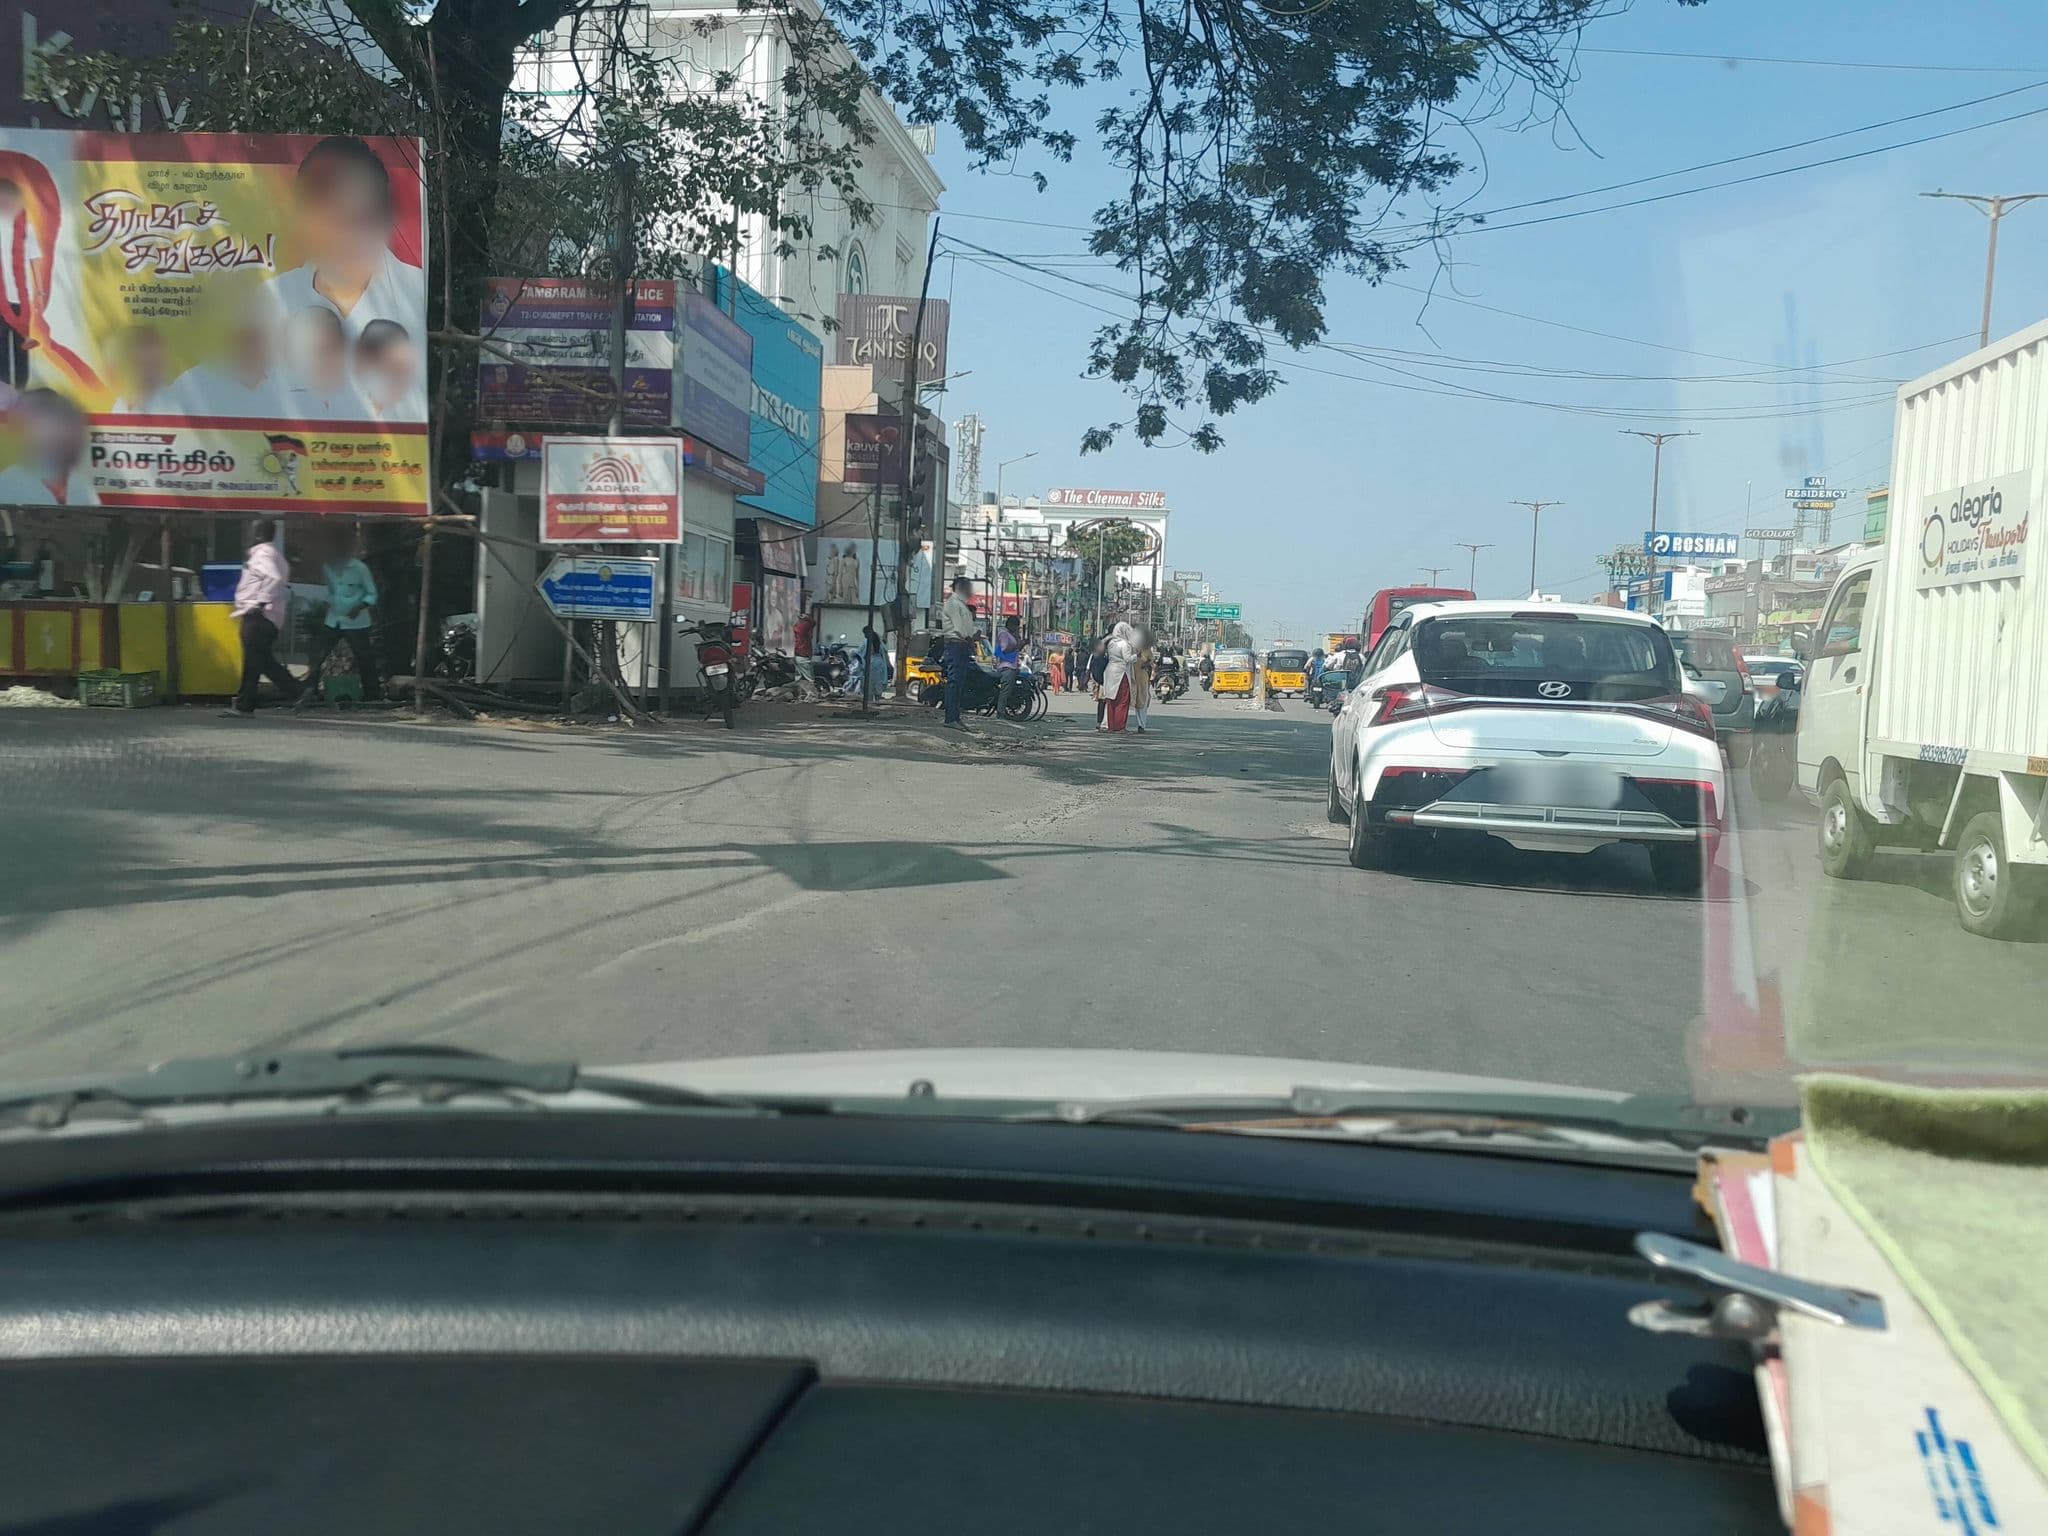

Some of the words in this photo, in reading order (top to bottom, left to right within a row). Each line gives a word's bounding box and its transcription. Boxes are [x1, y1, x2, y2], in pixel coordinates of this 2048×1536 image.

[521, 286, 586, 299] TAMBARAM
[311, 441, 328, 453] 27
[846, 438, 894, 456] kauvey
[92, 446, 235, 476] P.செந்தில்
[585, 484, 641, 493] AADHAR
[1808, 477, 1826, 486] JAI
[1063, 489, 1083, 504] The
[1087, 490, 1134, 506] Chennai
[1137, 491, 1165, 506] Silks
[1786, 488, 1848, 500] RESIDENCY
[1950, 485, 2002, 528] alegria
[1746, 528, 1760, 538] GO
[1761, 528, 1797, 538] COLORS
[1672, 537, 1738, 555] ROSHAN
[1947, 536, 1980, 554] HOLIDAYS
